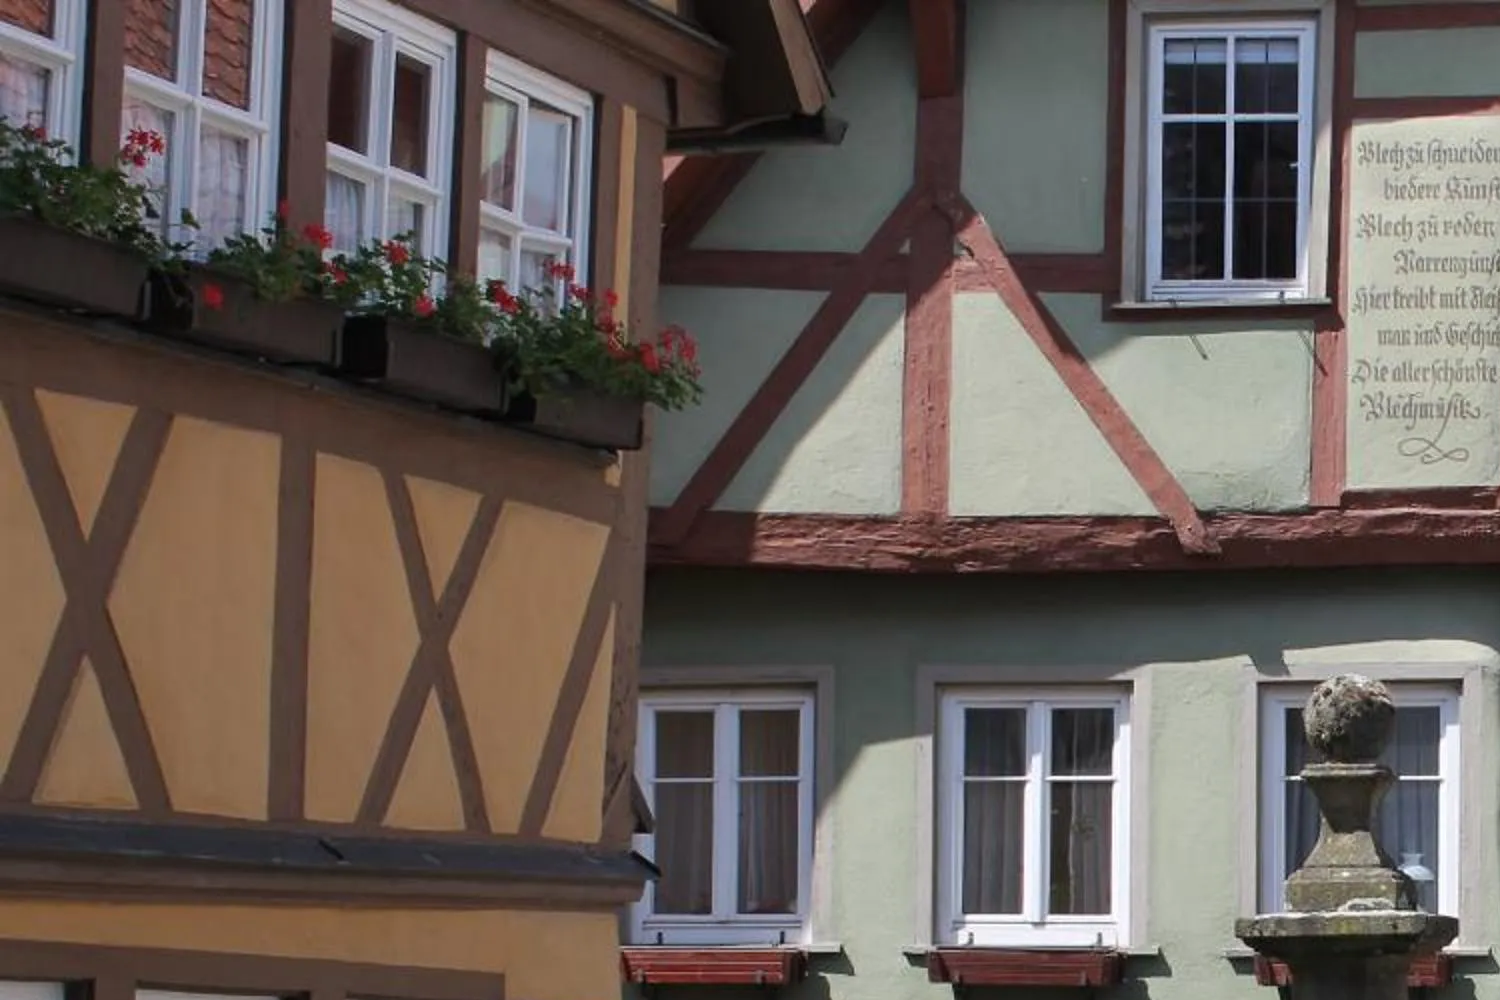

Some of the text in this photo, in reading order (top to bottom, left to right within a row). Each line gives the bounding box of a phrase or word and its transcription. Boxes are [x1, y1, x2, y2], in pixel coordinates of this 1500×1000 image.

[1357, 140, 1404, 172] Blech
[1383, 176, 1441, 201] biedere
[1356, 212, 1413, 243] Blech
[1443, 211, 1496, 238] reden
[1352, 285, 1391, 316] Hier
[1439, 286, 1467, 310] mit
[1377, 328, 1411, 347] man
[1352, 357, 1389, 384] Die
